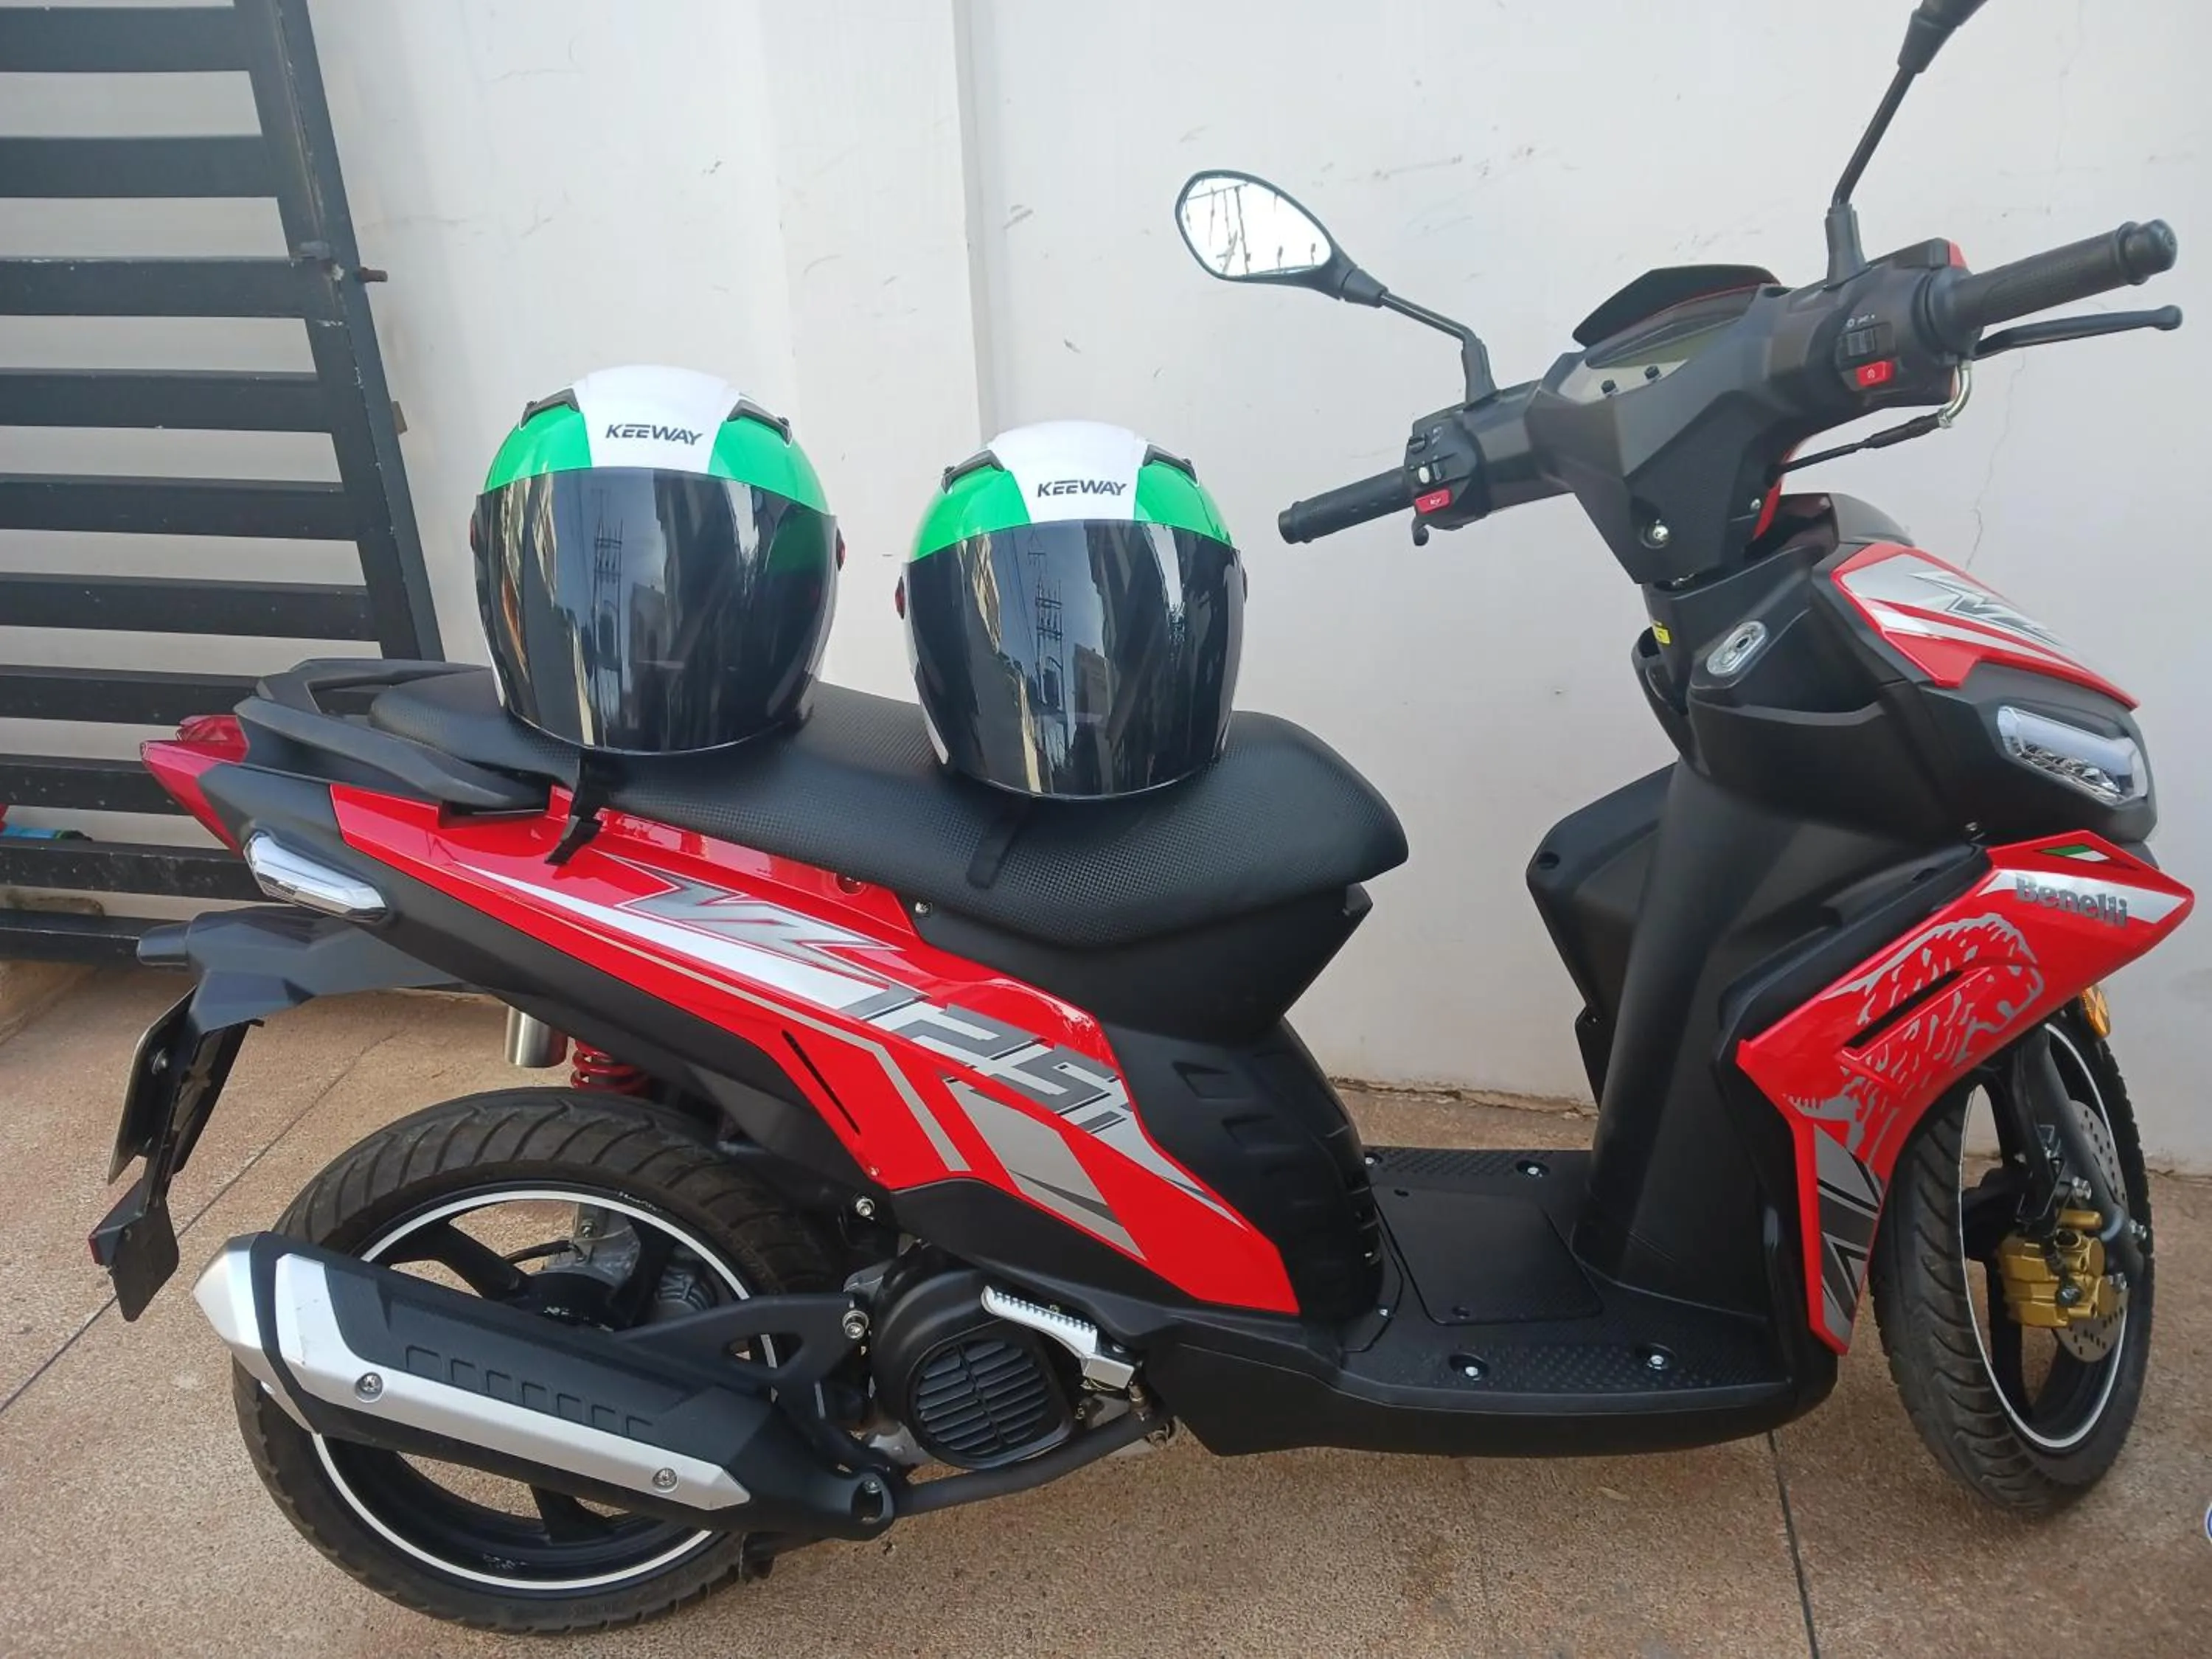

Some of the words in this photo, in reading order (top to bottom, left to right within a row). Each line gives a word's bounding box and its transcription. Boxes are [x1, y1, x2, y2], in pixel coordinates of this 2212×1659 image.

[605, 423, 703, 446] KEEWAY
[1037, 479, 1127, 498] KEEWAY
[2015, 873, 2128, 928] Benelli
